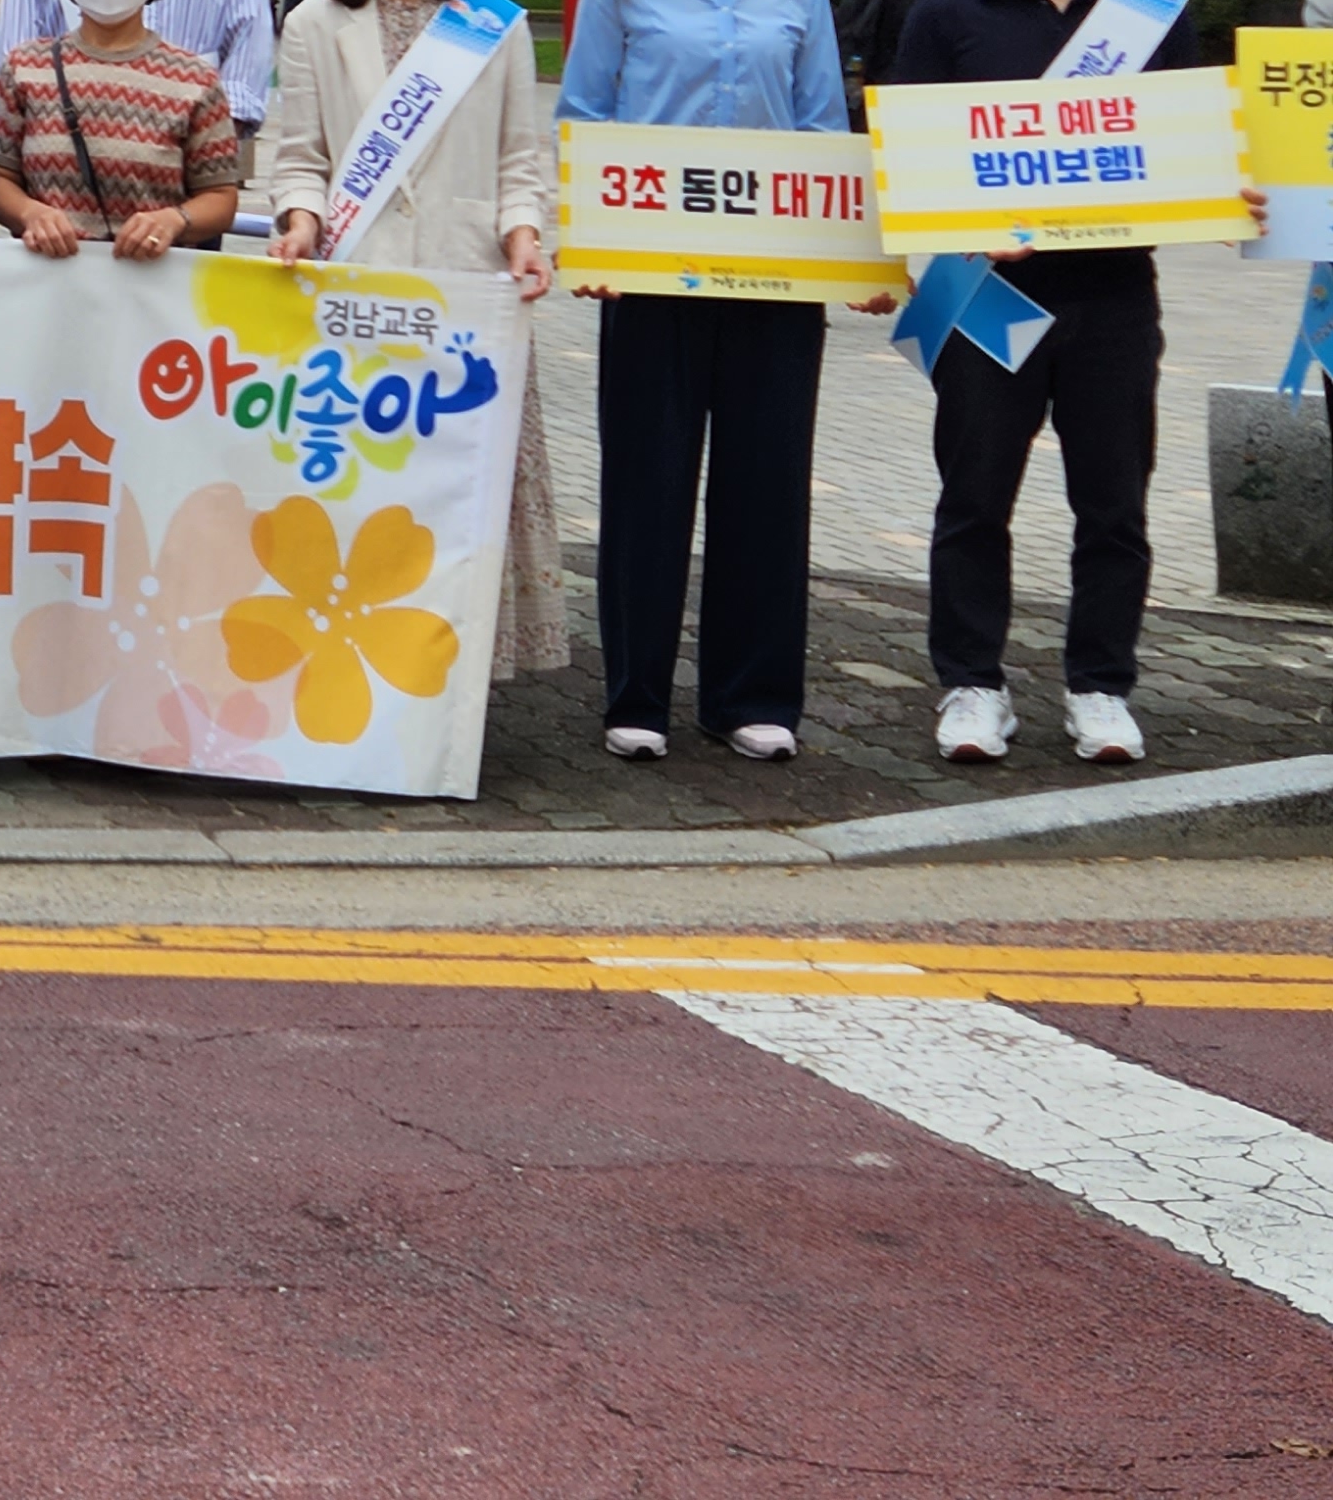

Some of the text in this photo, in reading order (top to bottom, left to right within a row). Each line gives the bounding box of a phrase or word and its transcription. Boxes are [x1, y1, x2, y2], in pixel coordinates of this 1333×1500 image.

[1259, 61, 1333, 108] 부정
[969, 97, 1138, 141] 사고 예방
[973, 144, 1149, 189] 방어보행!
[601, 164, 864, 223] 3초 동안 대기!
[323, 299, 439, 344] 경남교육
[139, 332, 498, 484] 아이좋아
